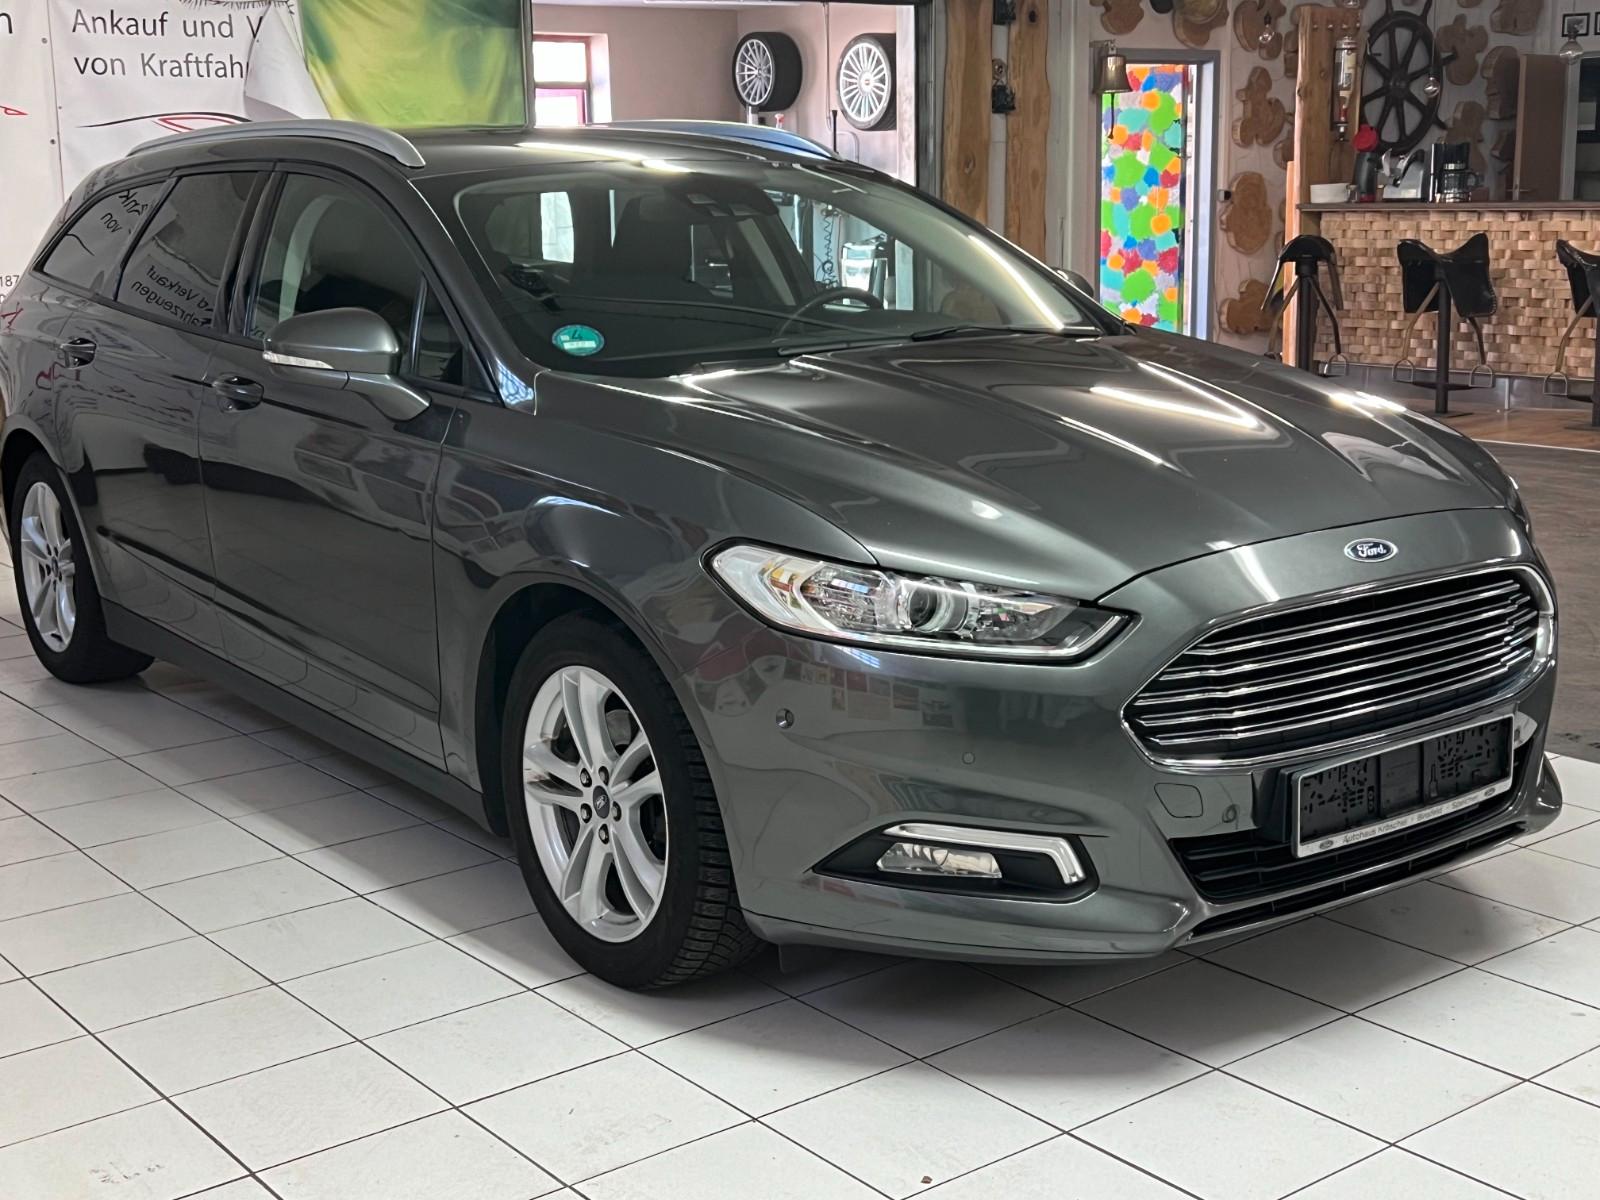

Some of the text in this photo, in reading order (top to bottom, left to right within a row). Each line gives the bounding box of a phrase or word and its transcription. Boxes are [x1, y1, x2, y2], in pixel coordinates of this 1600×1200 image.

[72, 9, 168, 36] Ankauf
[183, 14, 233, 38] und
[74, 57, 126, 75] von
[1356, 542, 1387, 557] Ford
